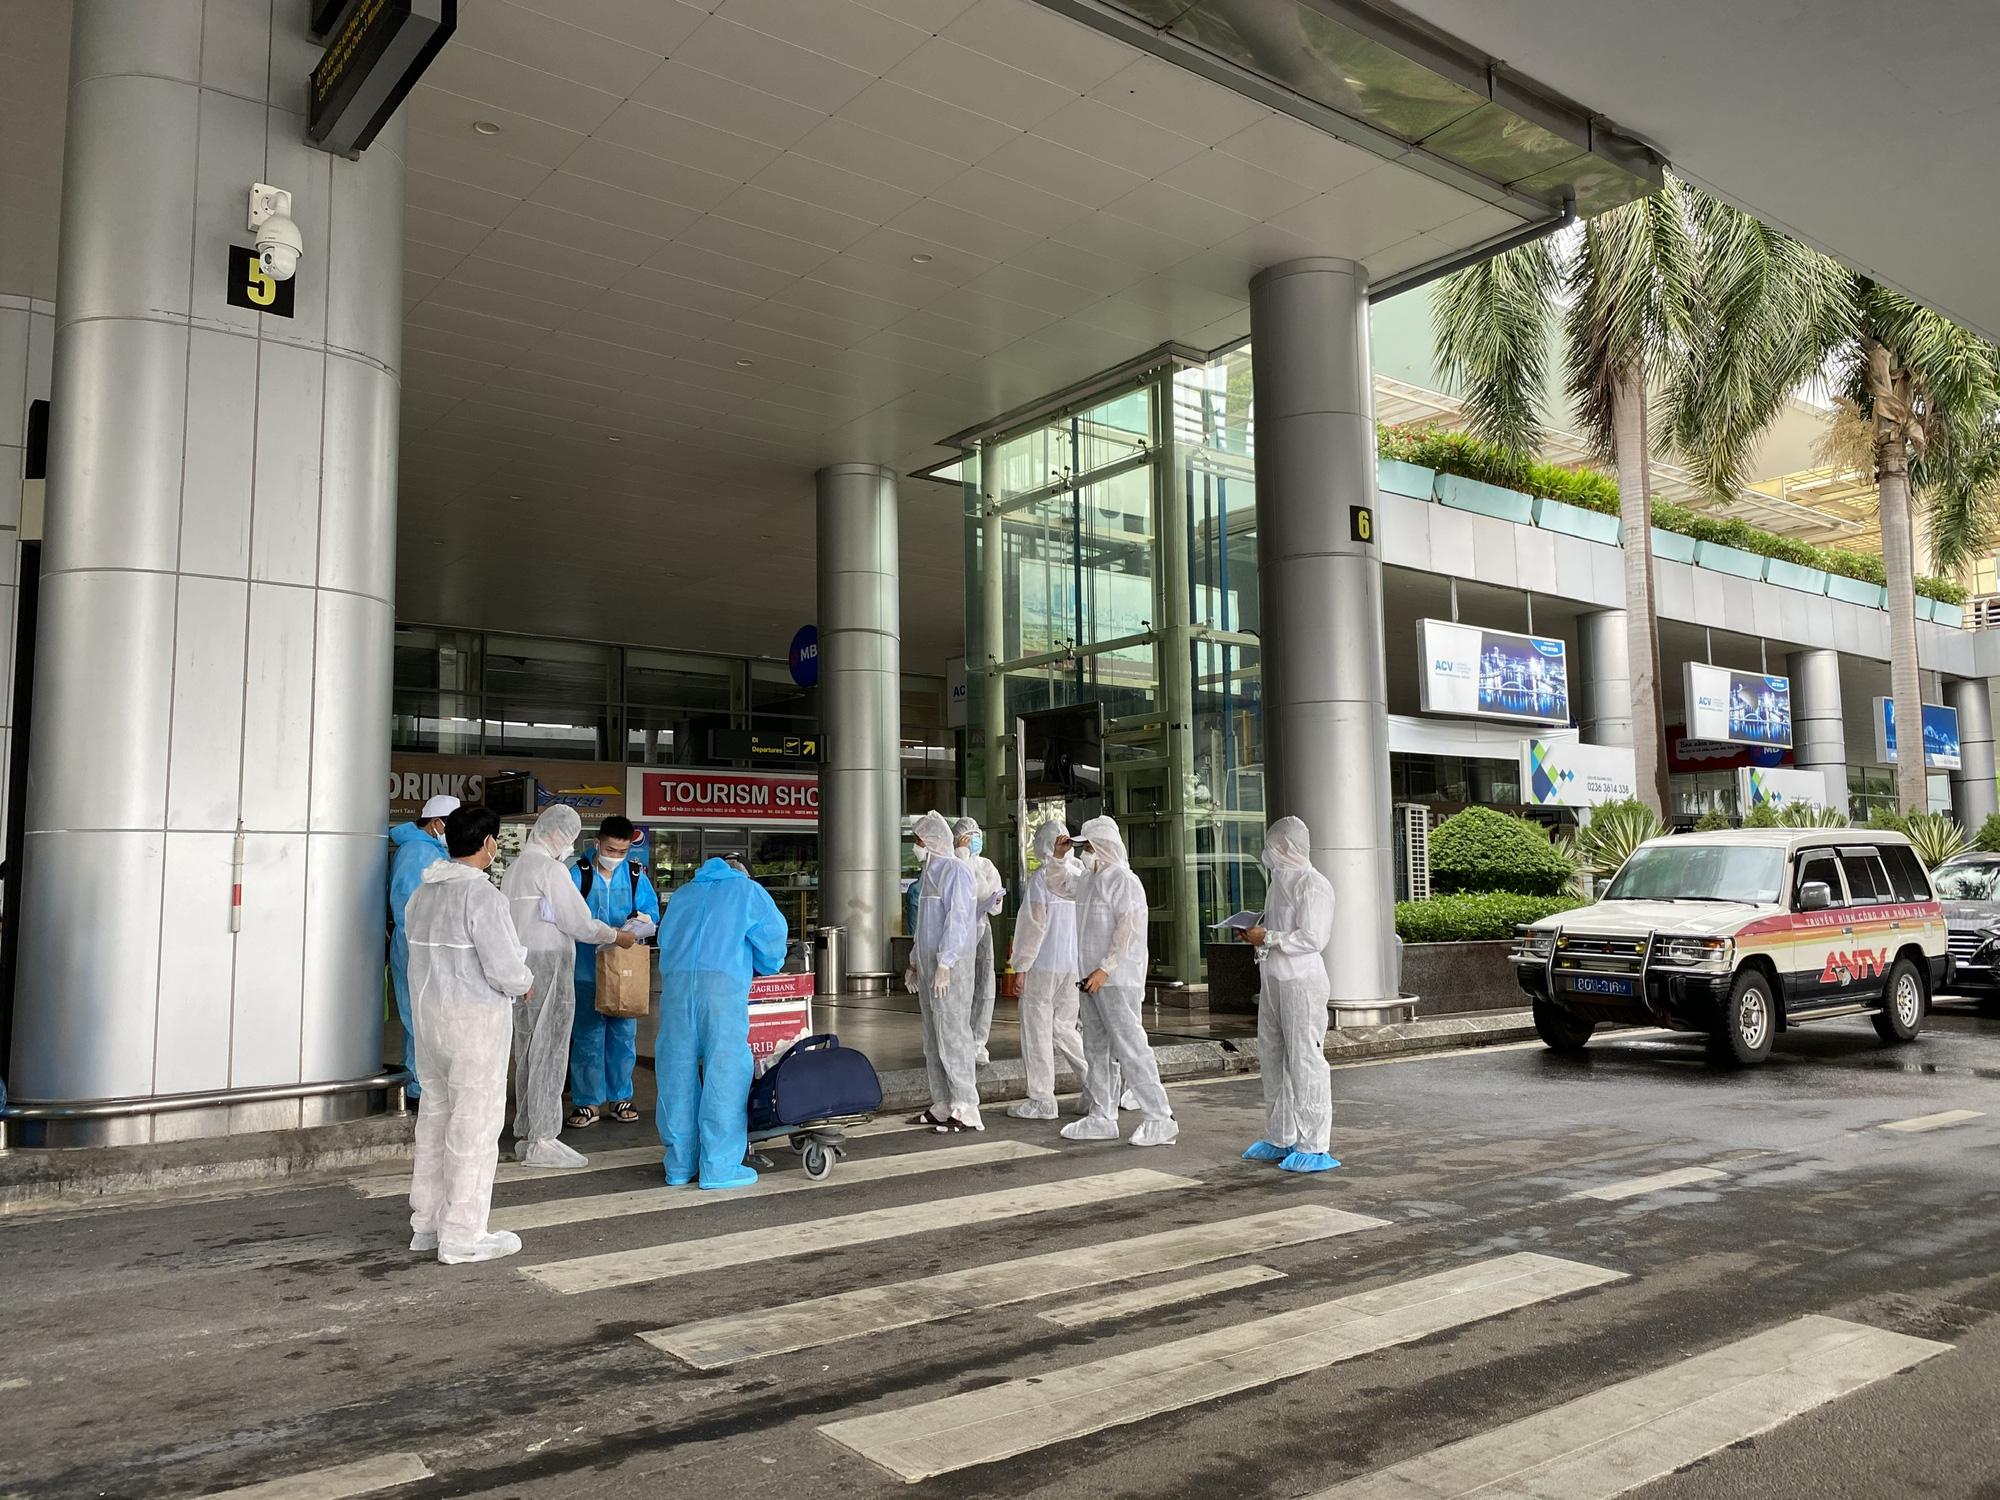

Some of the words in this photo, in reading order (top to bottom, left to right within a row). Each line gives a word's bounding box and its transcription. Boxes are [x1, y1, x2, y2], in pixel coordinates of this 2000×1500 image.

[247, 257, 276, 306] 5
[1358, 510, 1370, 539] 6
[800, 644, 818, 662] MB
[1435, 660, 1453, 671] ACV
[1698, 697, 1712, 706] ACV
[389, 772, 483, 802] DRINKS
[660, 781, 769, 806] TOURISM
[1587, 782, 1602, 792] 0236
[1603, 783, 1618, 794] 3614
[1618, 784, 1630, 795] 338
[1881, 910, 1890, 919] AN
[1819, 947, 1887, 983] ANTV
[756, 984, 796, 993] AGRIBANK
[749, 1041, 775, 1053] RIB
